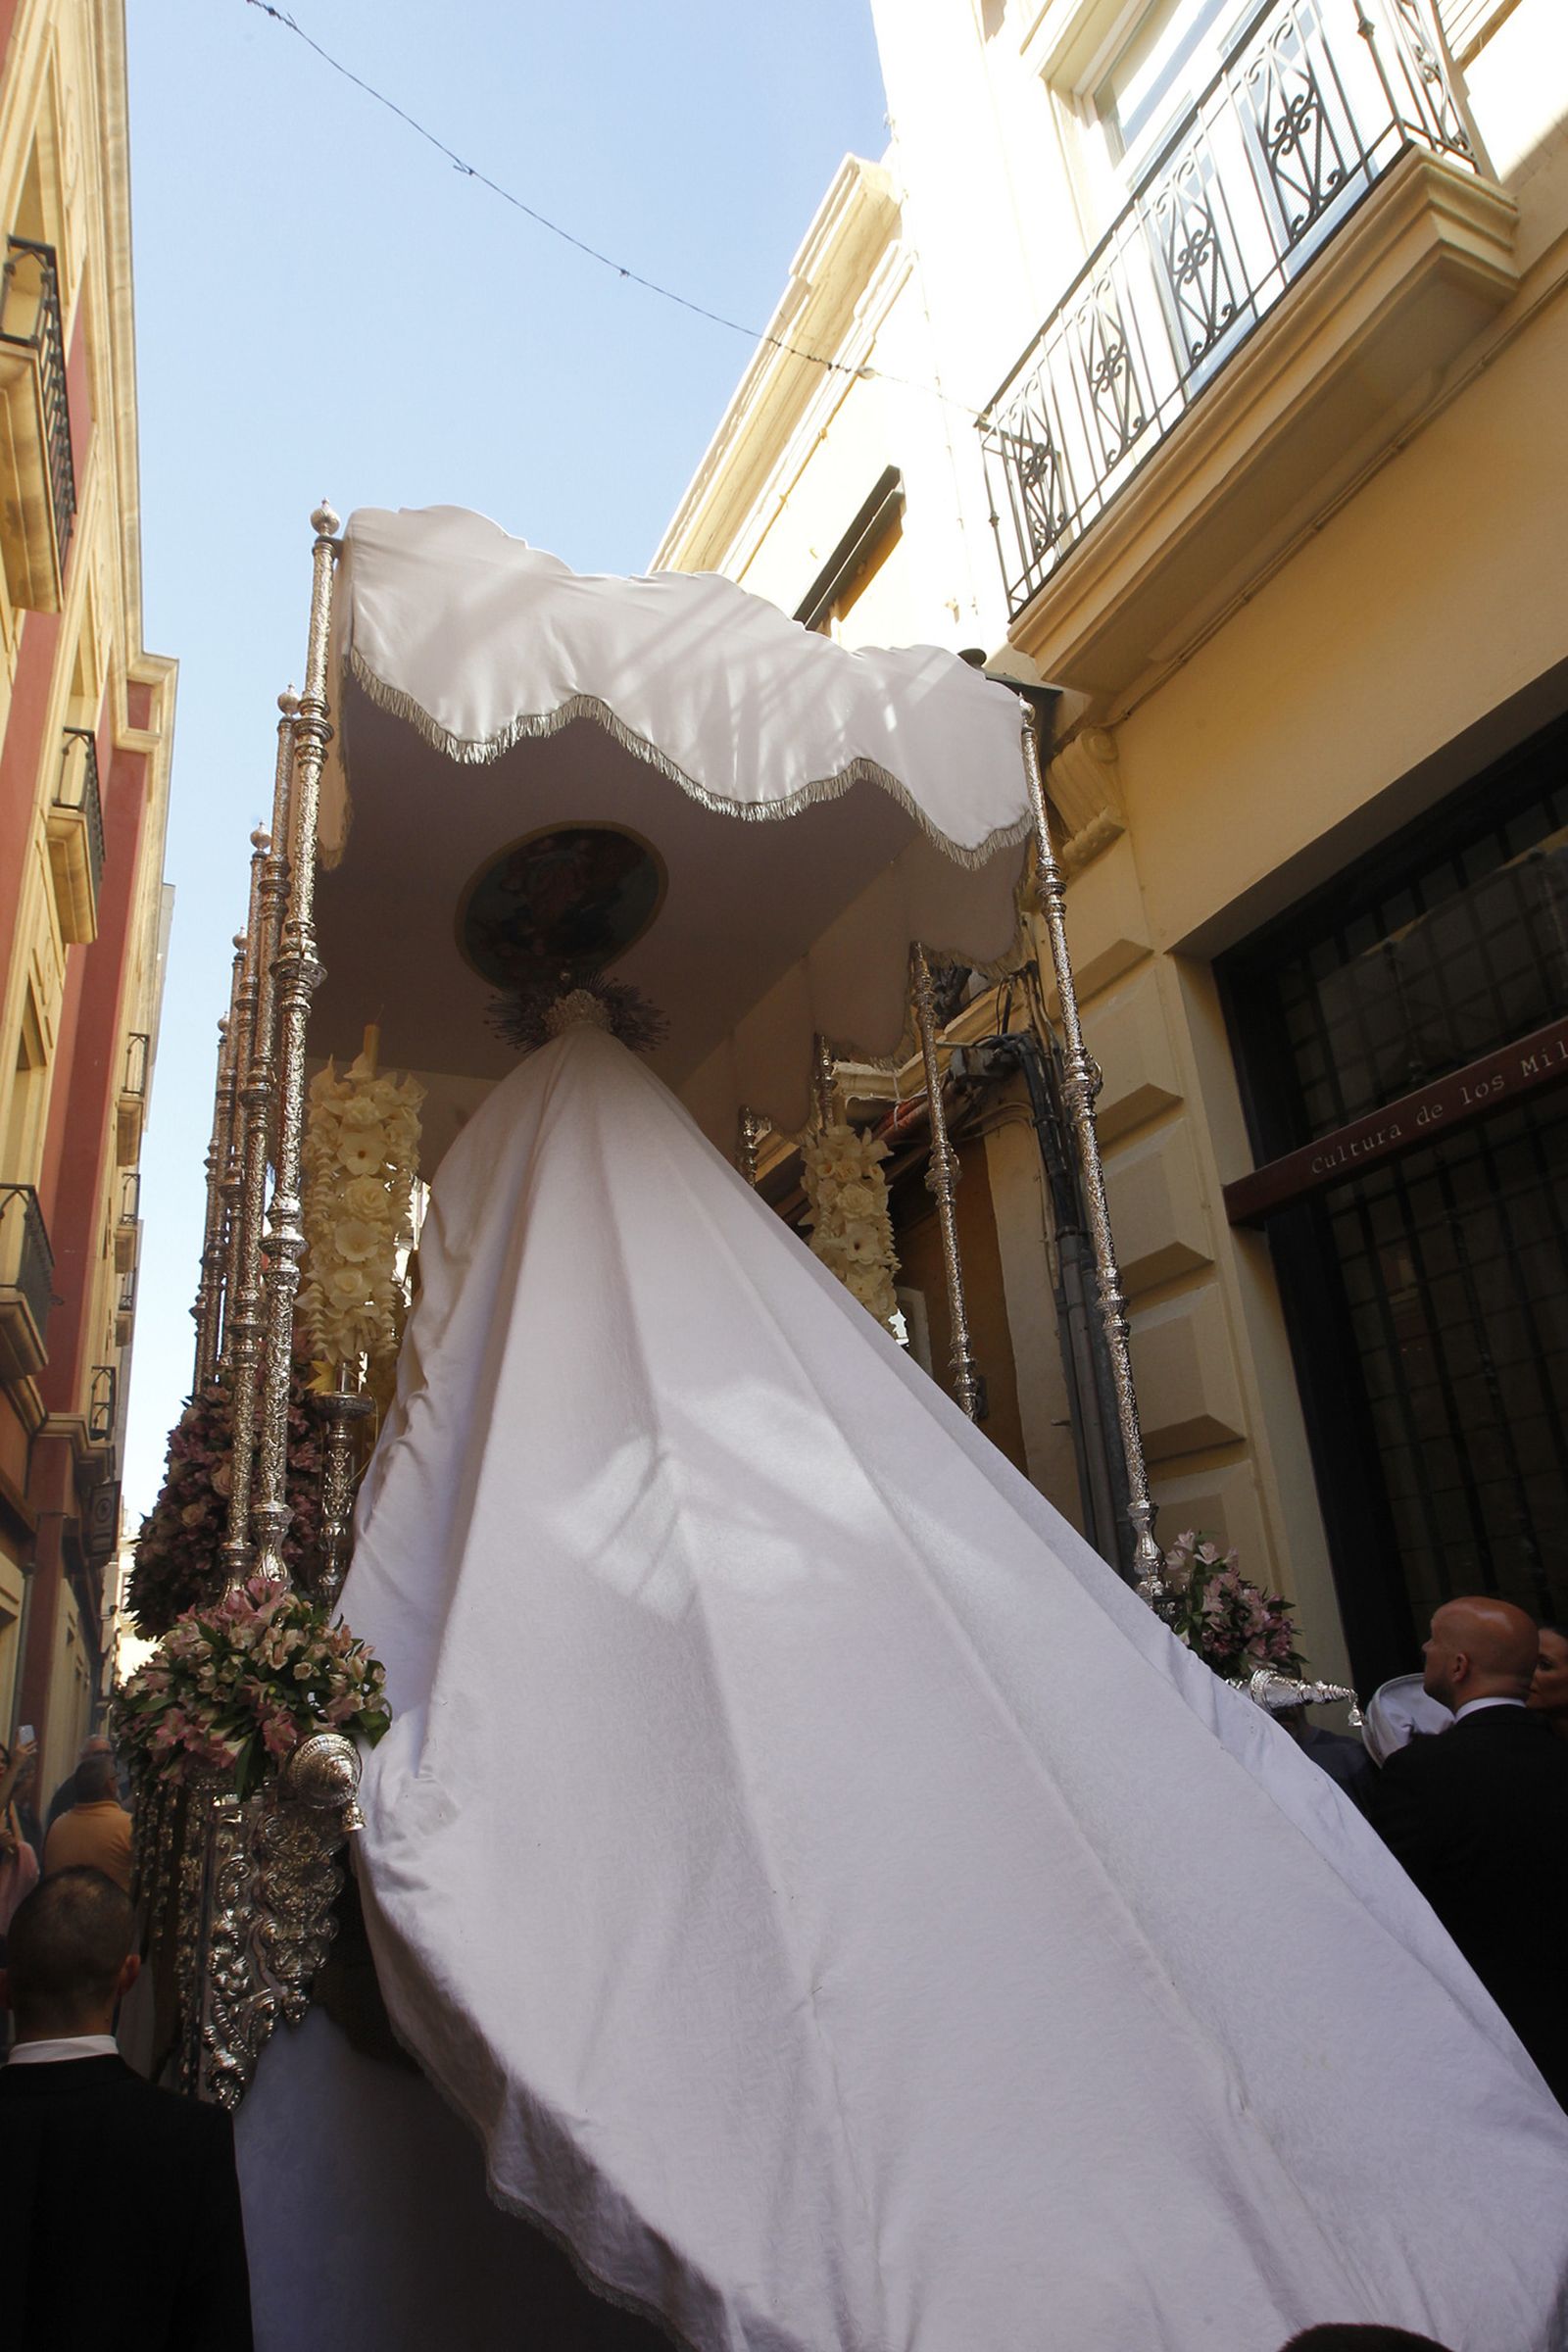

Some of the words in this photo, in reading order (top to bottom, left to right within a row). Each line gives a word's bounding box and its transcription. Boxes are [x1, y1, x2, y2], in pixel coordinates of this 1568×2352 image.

[1310, 1124, 1402, 1174] Cultura
[1416, 1103, 1444, 1126] de
[1461, 1074, 1505, 1105] los
